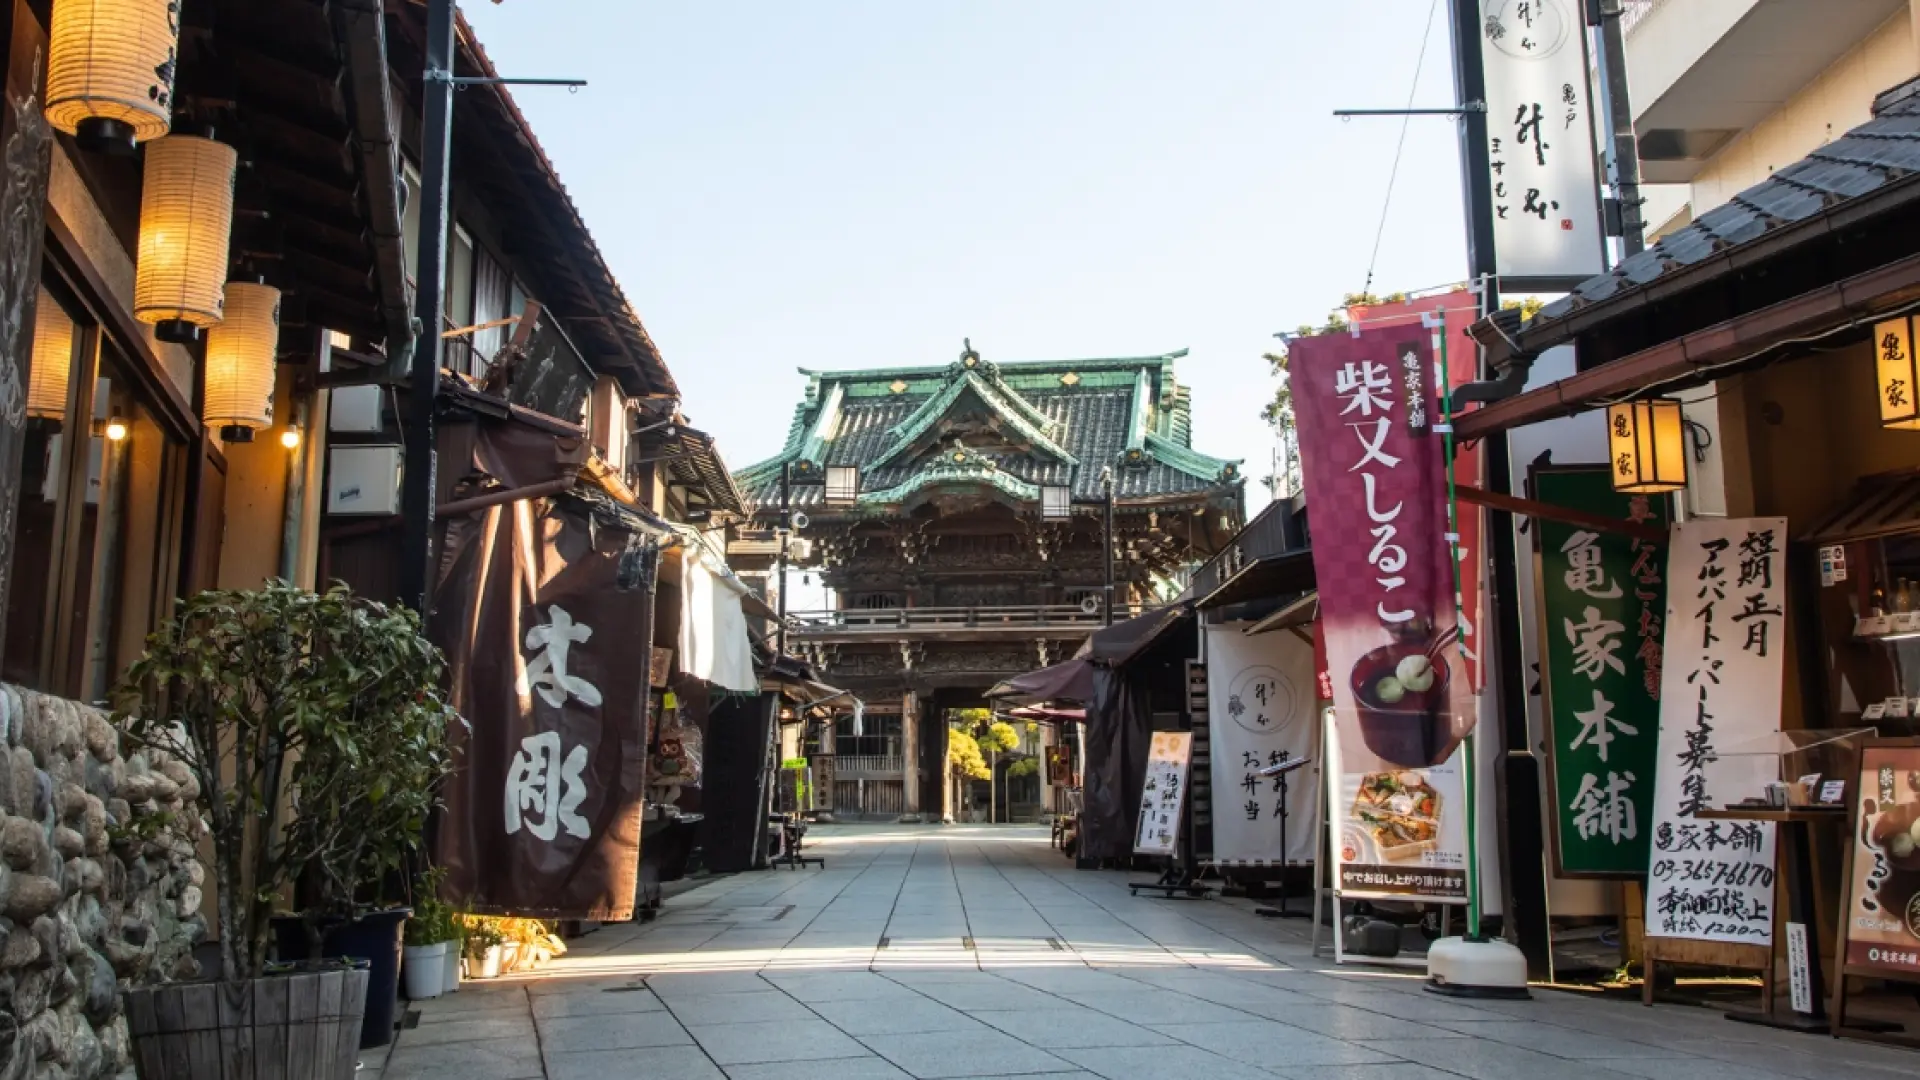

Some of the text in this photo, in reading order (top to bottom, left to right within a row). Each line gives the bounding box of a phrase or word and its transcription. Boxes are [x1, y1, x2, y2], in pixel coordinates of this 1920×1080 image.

[1491, 137, 1507, 219] ますもと
[1334, 359, 1416, 624] 柴又しるこ
[504, 604, 604, 842] 木彫
[1240, 750, 1263, 821] お弁当
[1560, 529, 1640, 846] 亀家本舗
